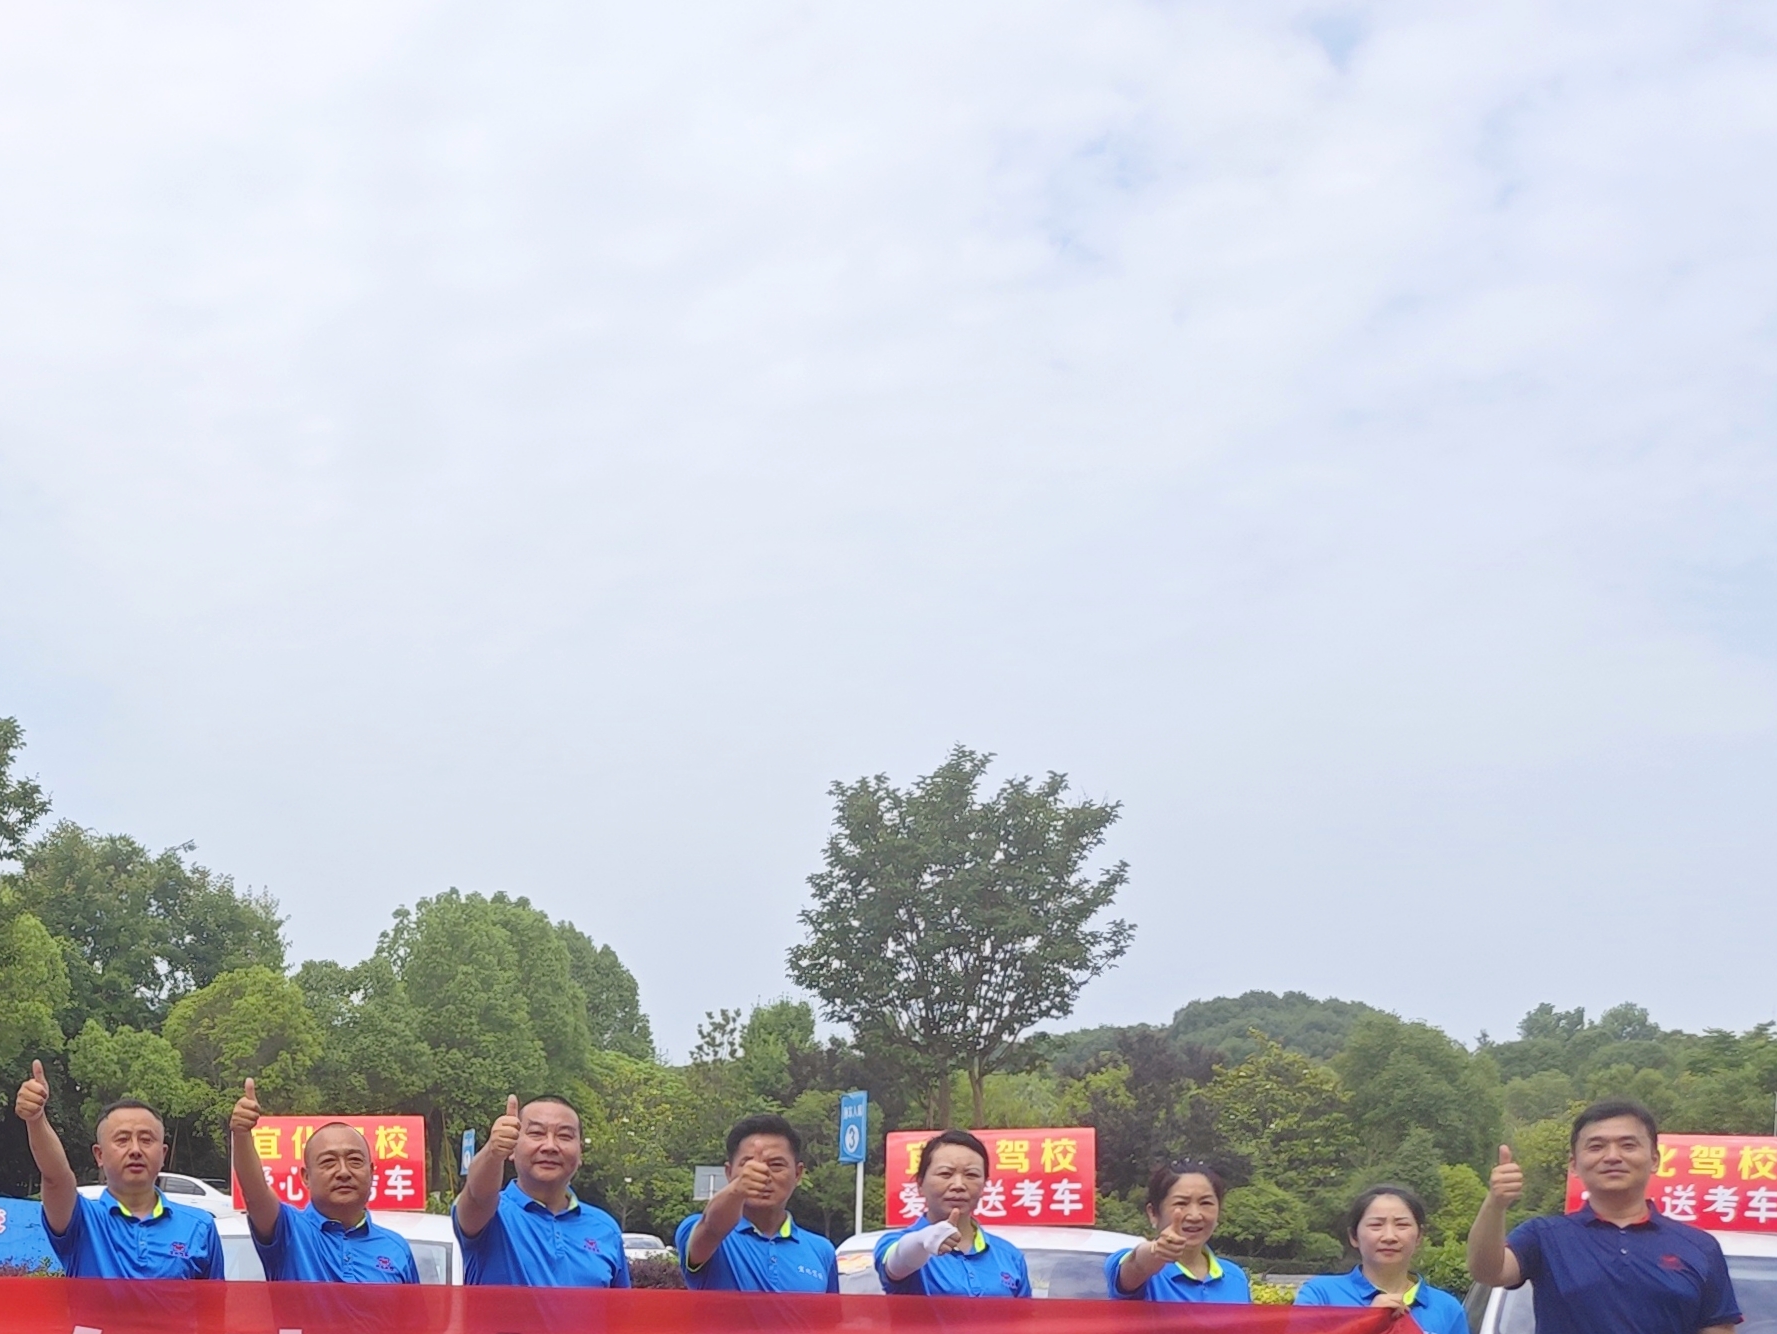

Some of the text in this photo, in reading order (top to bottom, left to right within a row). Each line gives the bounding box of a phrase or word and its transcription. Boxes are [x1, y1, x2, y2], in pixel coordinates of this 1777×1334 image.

[252, 1125, 409, 1160] 宜化校
[898, 1178, 1083, 1218] 爱送考车
